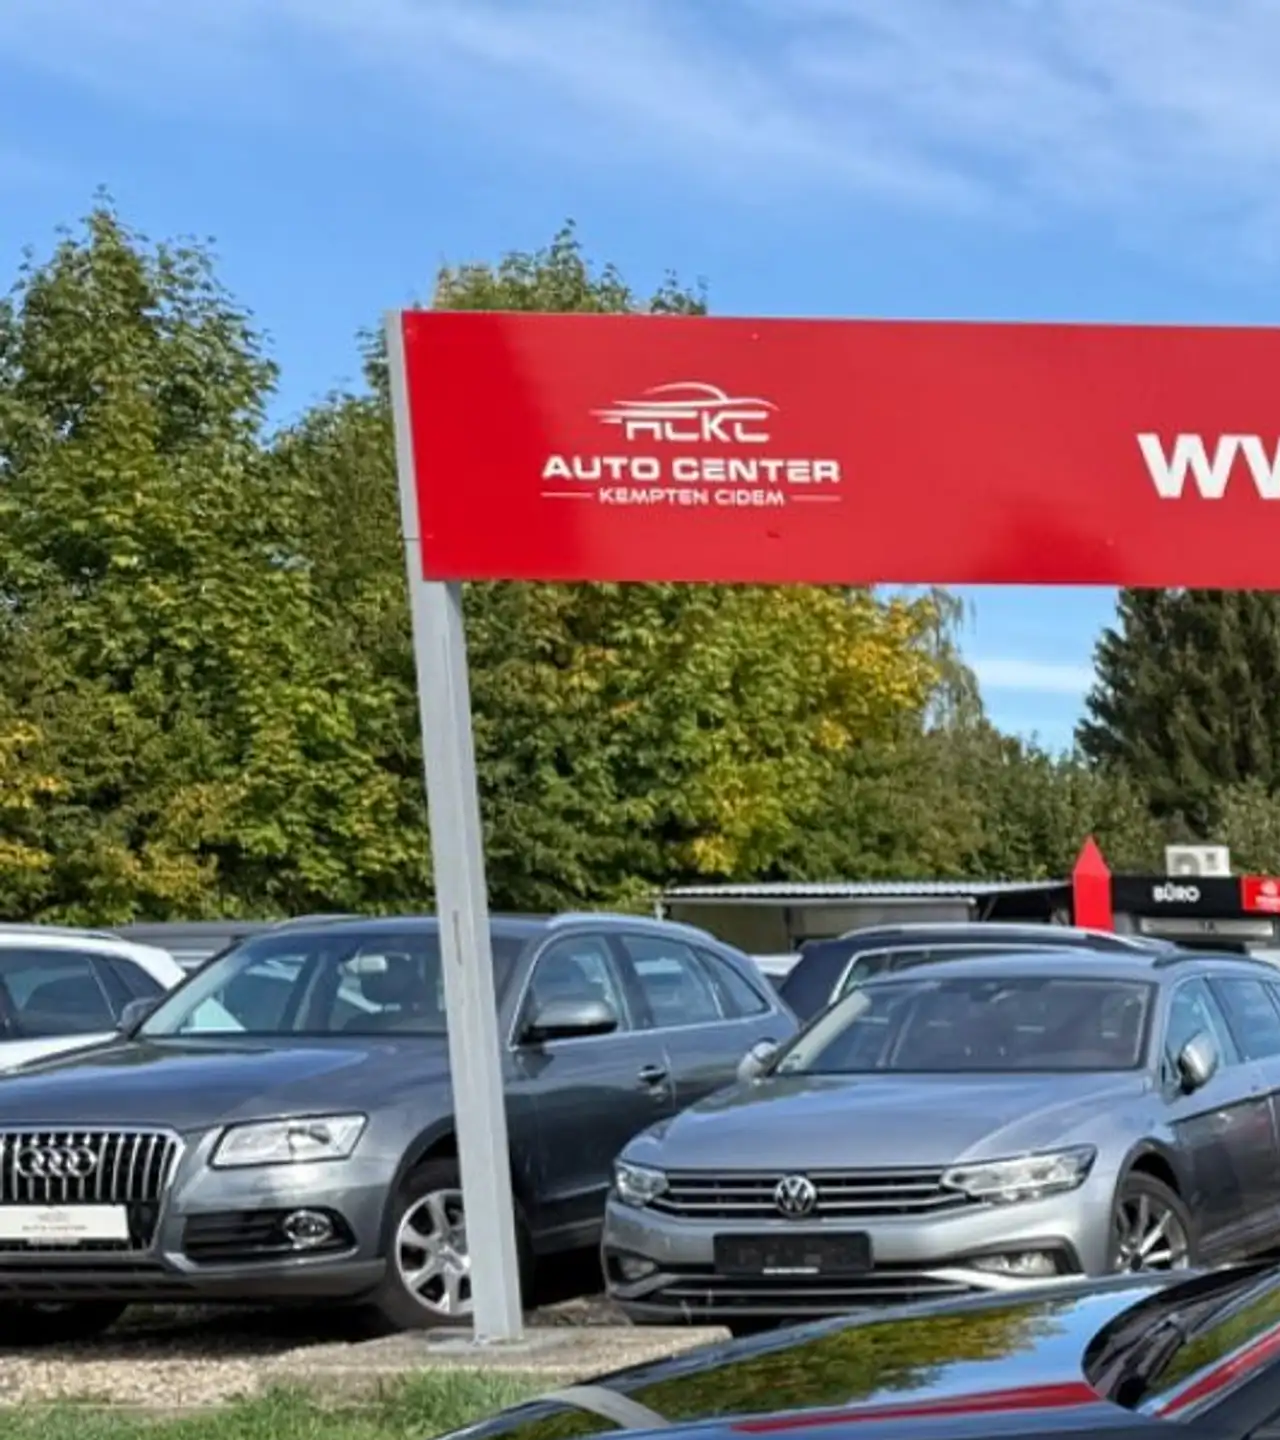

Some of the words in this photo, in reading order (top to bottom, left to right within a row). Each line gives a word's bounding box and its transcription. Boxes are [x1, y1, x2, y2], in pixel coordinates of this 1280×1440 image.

[542, 455, 661, 481] AUTO
[672, 456, 841, 484] CENTER
[599, 486, 709, 506] KEMPTEN
[714, 489, 786, 507] CIDEM
[1152, 881, 1201, 903] BÜRO
